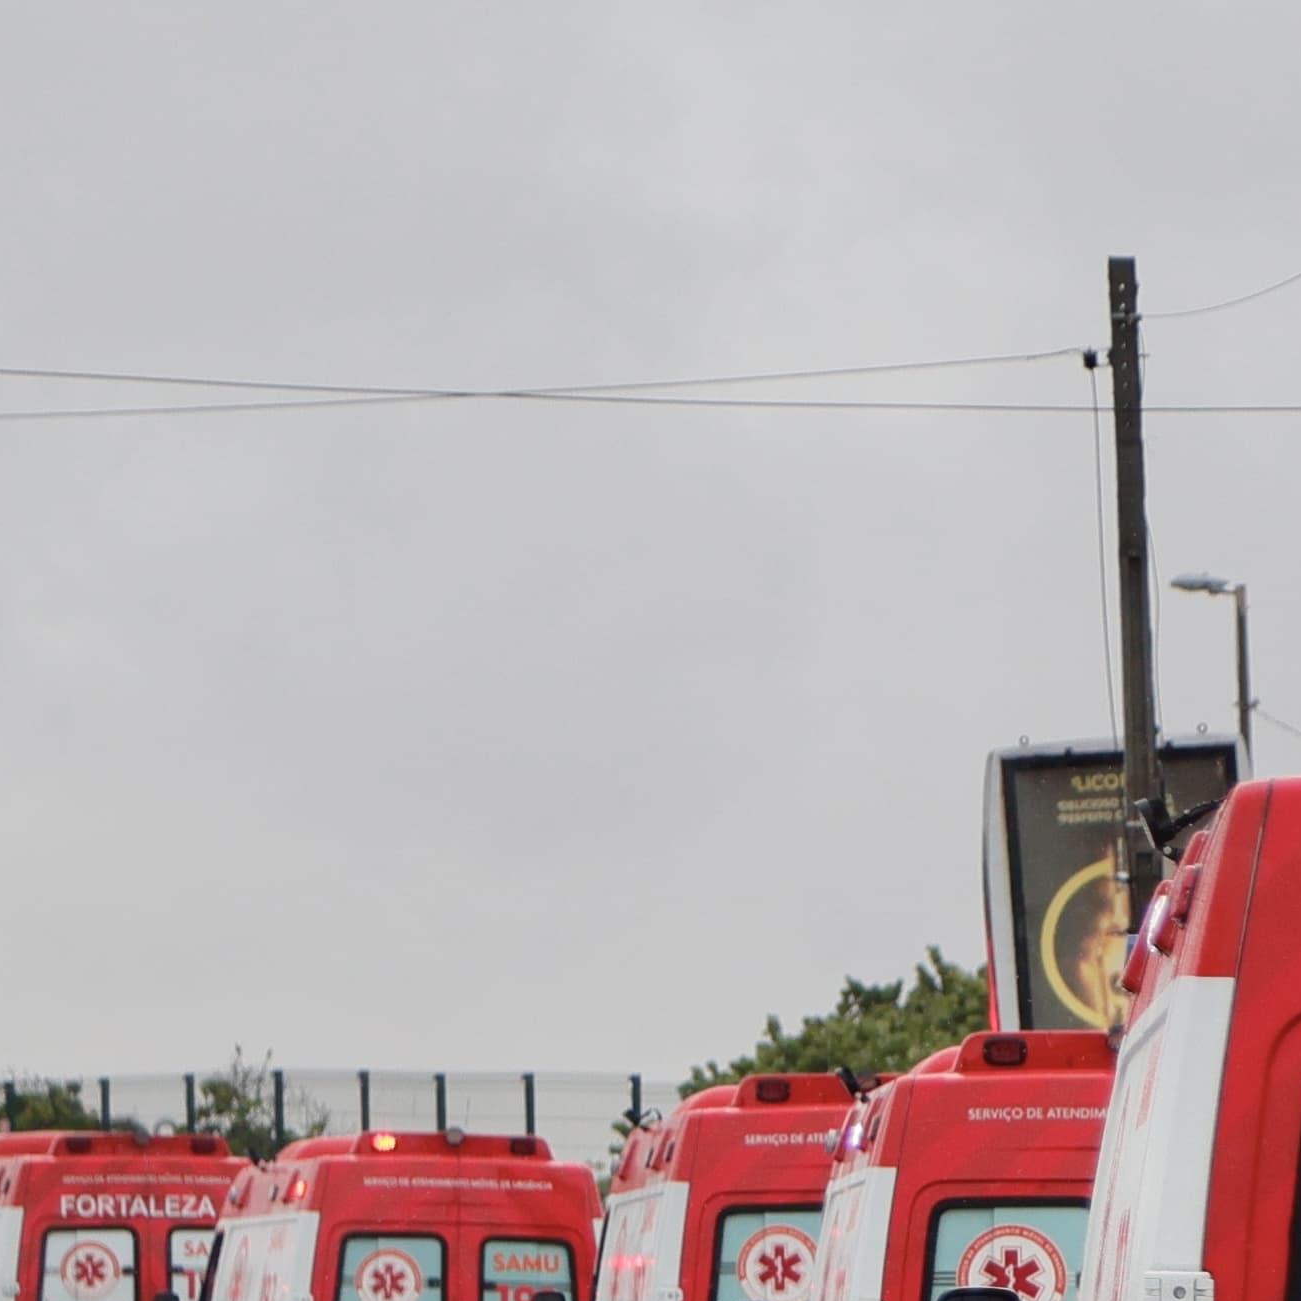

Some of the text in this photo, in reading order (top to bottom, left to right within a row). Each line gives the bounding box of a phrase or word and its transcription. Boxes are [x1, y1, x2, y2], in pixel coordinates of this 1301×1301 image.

[967, 1106, 1106, 1123] SERVIÇO DE ATENDIM
[60, 1193, 216, 1219] FORTALEZA
[184, 1240, 209, 1257] SA
[493, 1252, 560, 1273] SAMU
